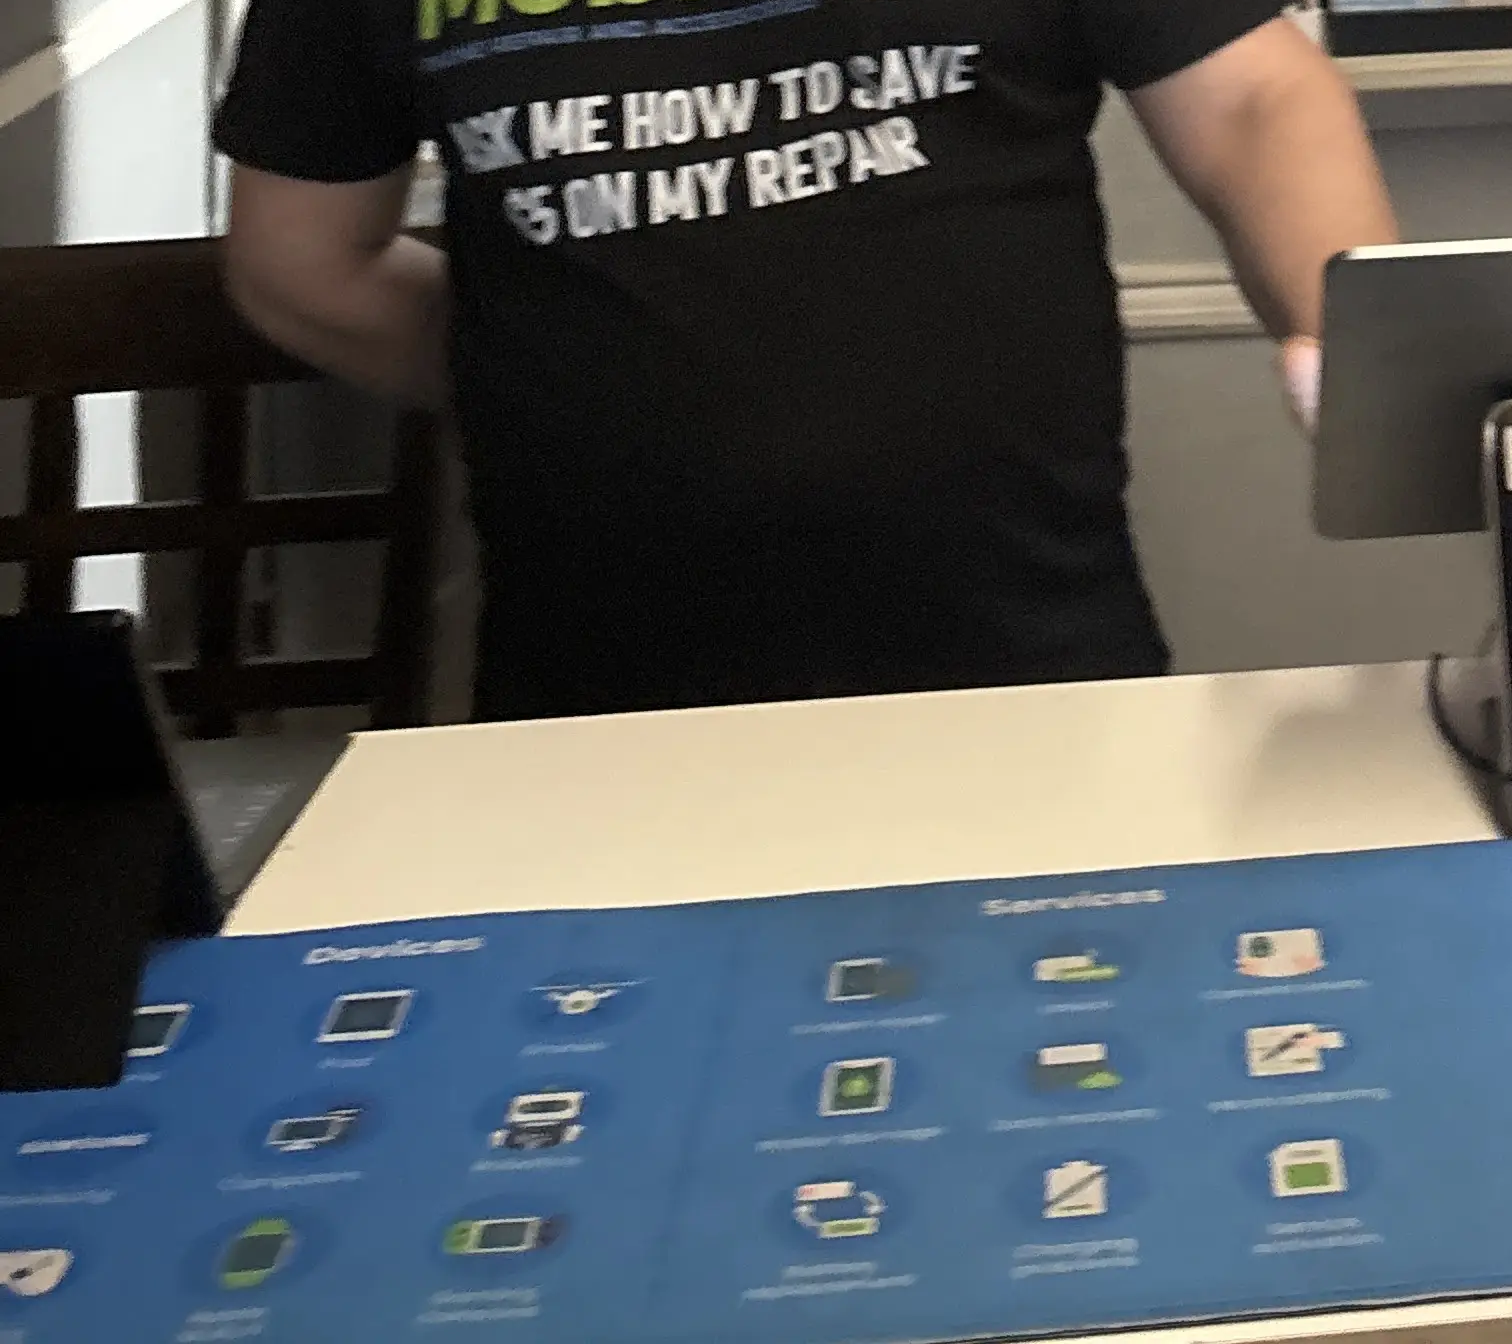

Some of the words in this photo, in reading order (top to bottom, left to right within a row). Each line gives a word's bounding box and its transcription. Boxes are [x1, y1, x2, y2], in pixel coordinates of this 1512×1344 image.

[527, 94, 612, 160] ME
[622, 78, 760, 150] HOW
[769, 60, 842, 121] TO
[845, 44, 981, 111] SAVE
[562, 170, 637, 239] ON
[647, 156, 734, 225] MY
[745, 115, 932, 209] REPAIR
